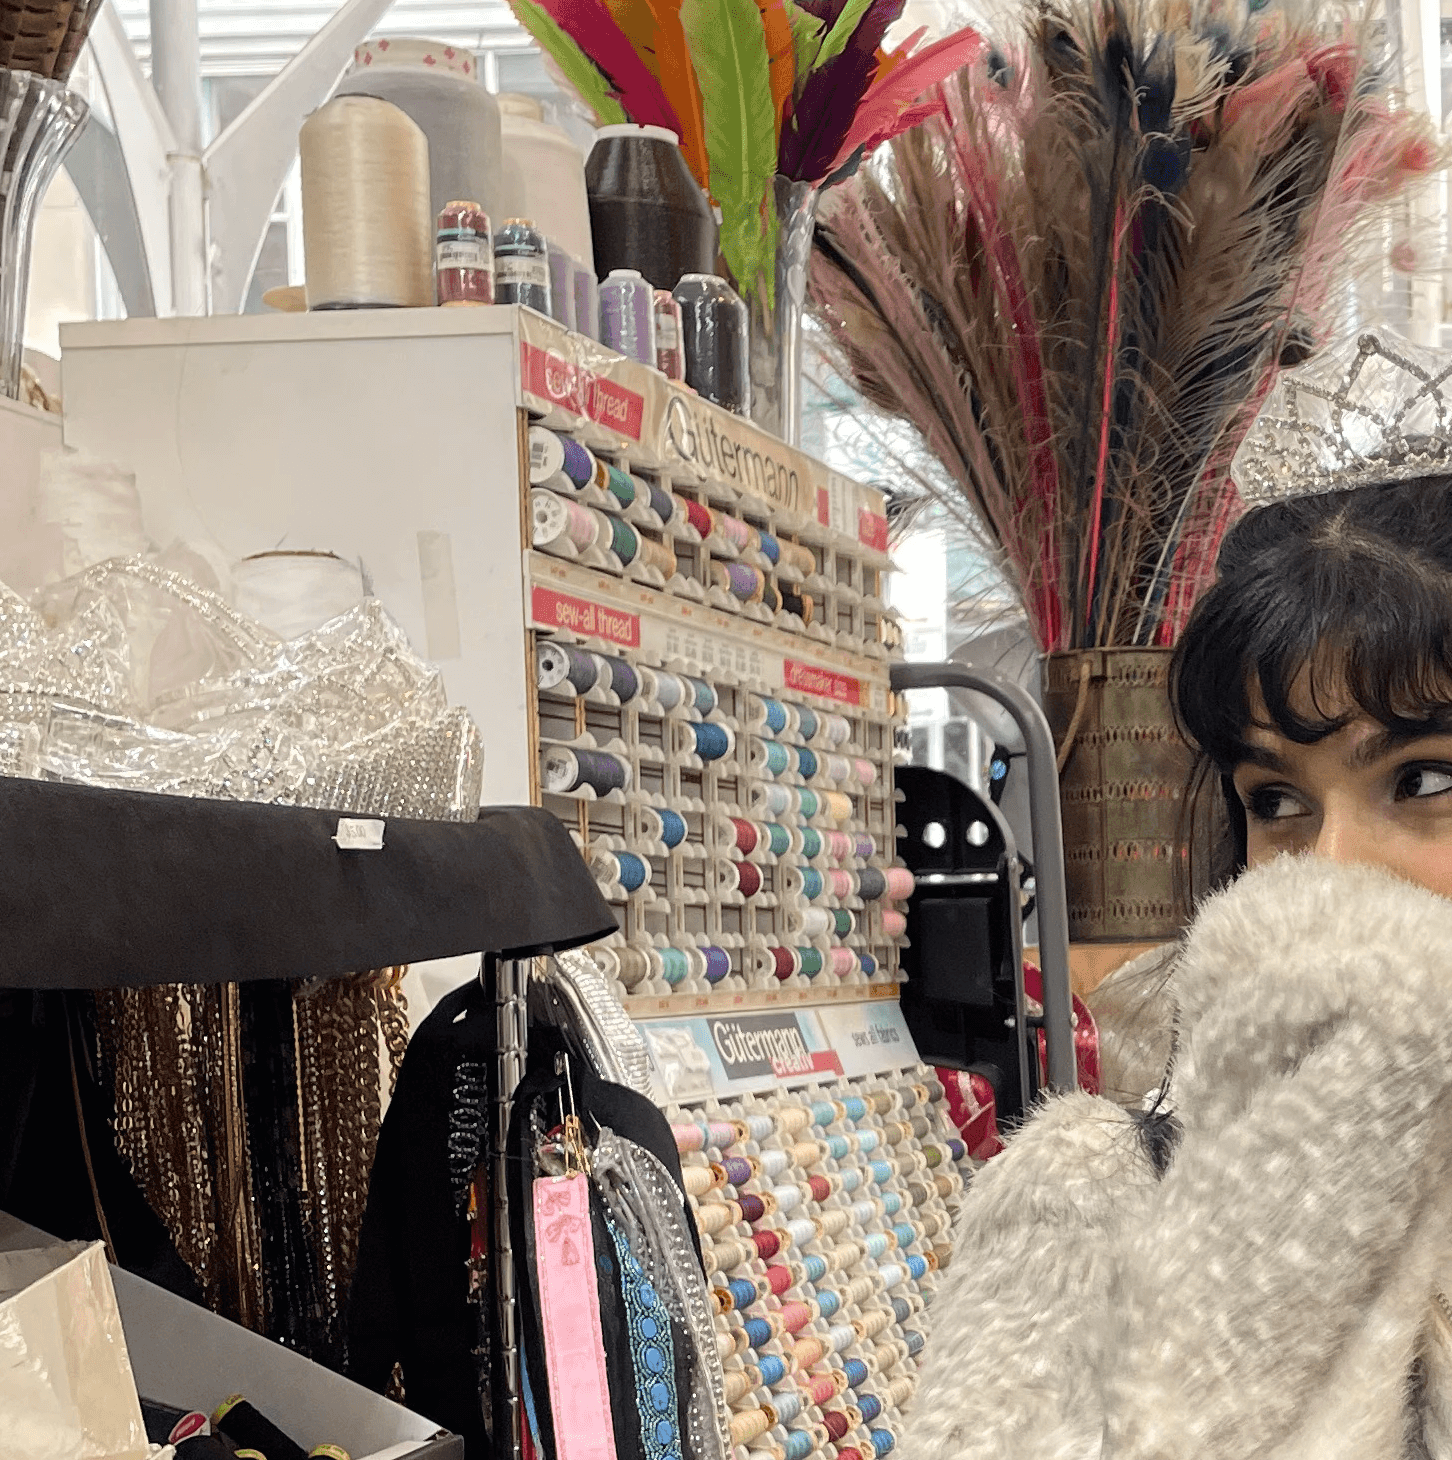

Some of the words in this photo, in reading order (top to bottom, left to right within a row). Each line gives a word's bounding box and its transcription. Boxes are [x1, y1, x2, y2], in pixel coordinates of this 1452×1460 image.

[668, 396, 799, 512] Gütermann
[556, 601, 595, 631] sew-all
[597, 608, 632, 641] thread
[714, 1020, 801, 1065] Gütermann
[771, 1053, 815, 1075] creativ
